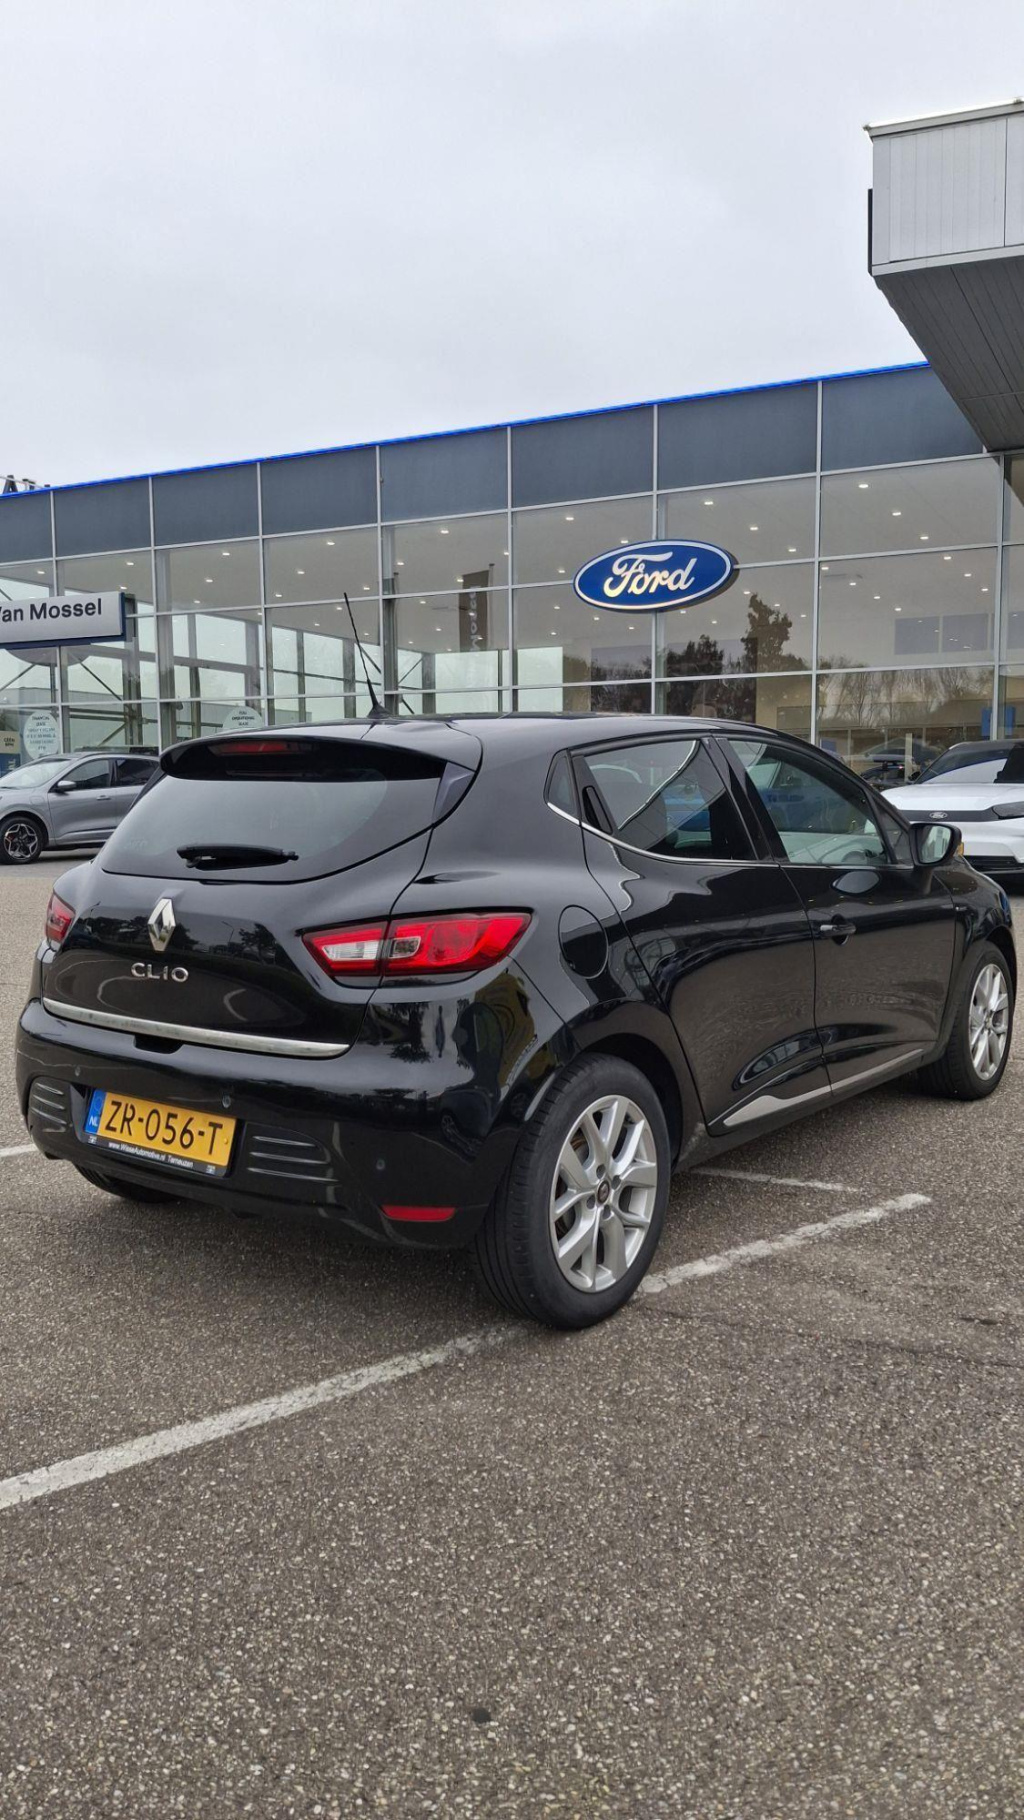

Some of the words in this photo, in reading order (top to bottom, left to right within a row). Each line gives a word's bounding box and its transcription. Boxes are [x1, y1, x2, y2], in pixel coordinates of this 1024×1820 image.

[603, 551, 697, 598] Ford
[0, 607, 24, 622] an
[30, 598, 102, 620] Mossel
[131, 962, 189, 982] CLIO
[89, 1116, 98, 1127] NL
[105, 1100, 223, 1155] ZR-056-T
